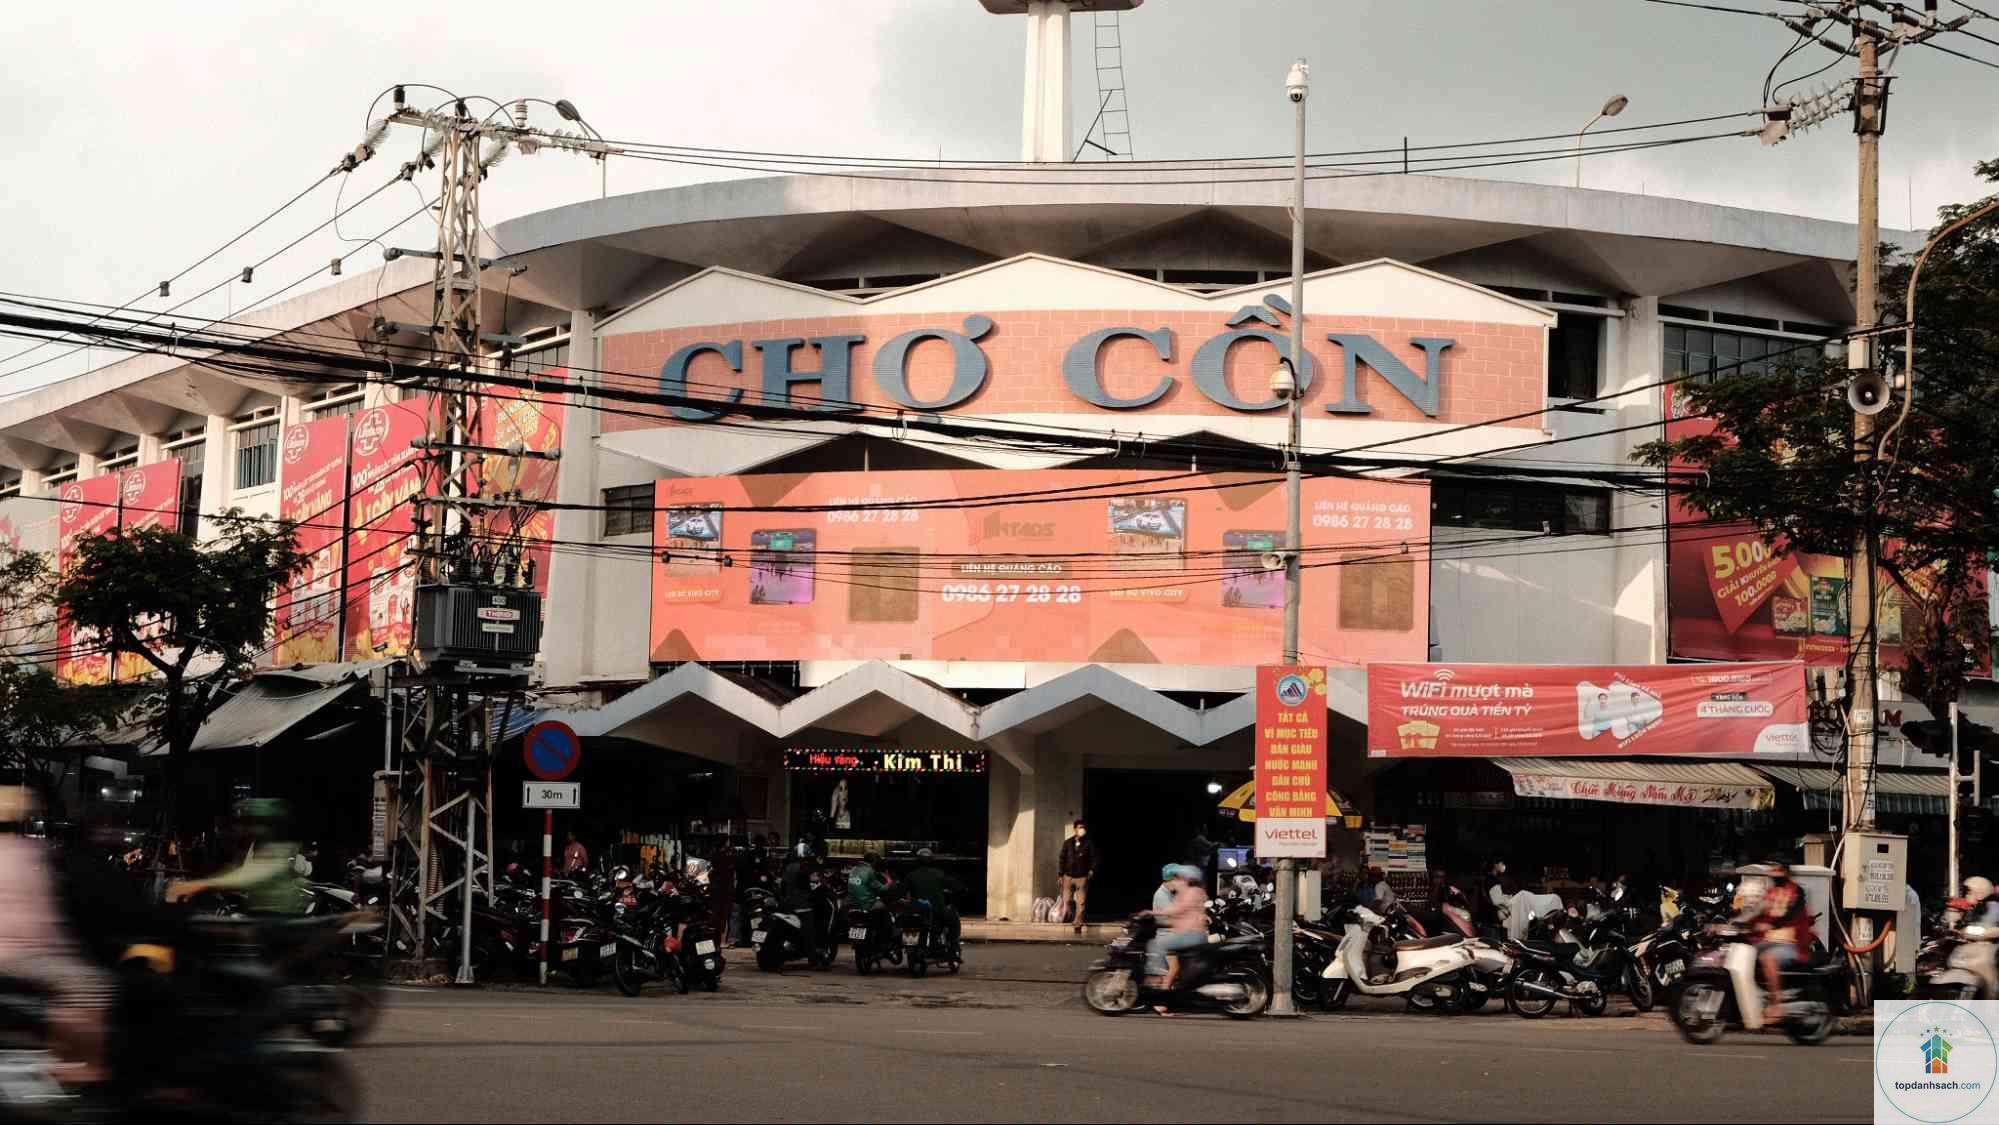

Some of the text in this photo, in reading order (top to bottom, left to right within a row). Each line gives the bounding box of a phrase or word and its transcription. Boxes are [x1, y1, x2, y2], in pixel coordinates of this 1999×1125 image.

[1062, 293, 1457, 417] CỒN
[1353, 515, 1368, 529] 27
[1374, 516, 1392, 529] 28
[942, 584, 1081, 602] 0986 27 28 28
[1401, 682, 1534, 700] WiFi mượt mà
[1402, 704, 1448, 716] TRÚNG
[1450, 704, 1479, 716] QUÀ
[1278, 710, 1309, 723] TẤT CẢ
[1264, 727, 1274, 738] VÌ
[1271, 743, 1289, 755] DÂN
[884, 754, 922, 769] Kim
[1272, 773, 1311, 786] DÂN CHỦ
[541, 789, 563, 799] 30m
[1265, 789, 1317, 801] CÔNG BẰNG
[1269, 805, 1312, 817] VĂN MINH
[1264, 828, 1318, 840] viettel
